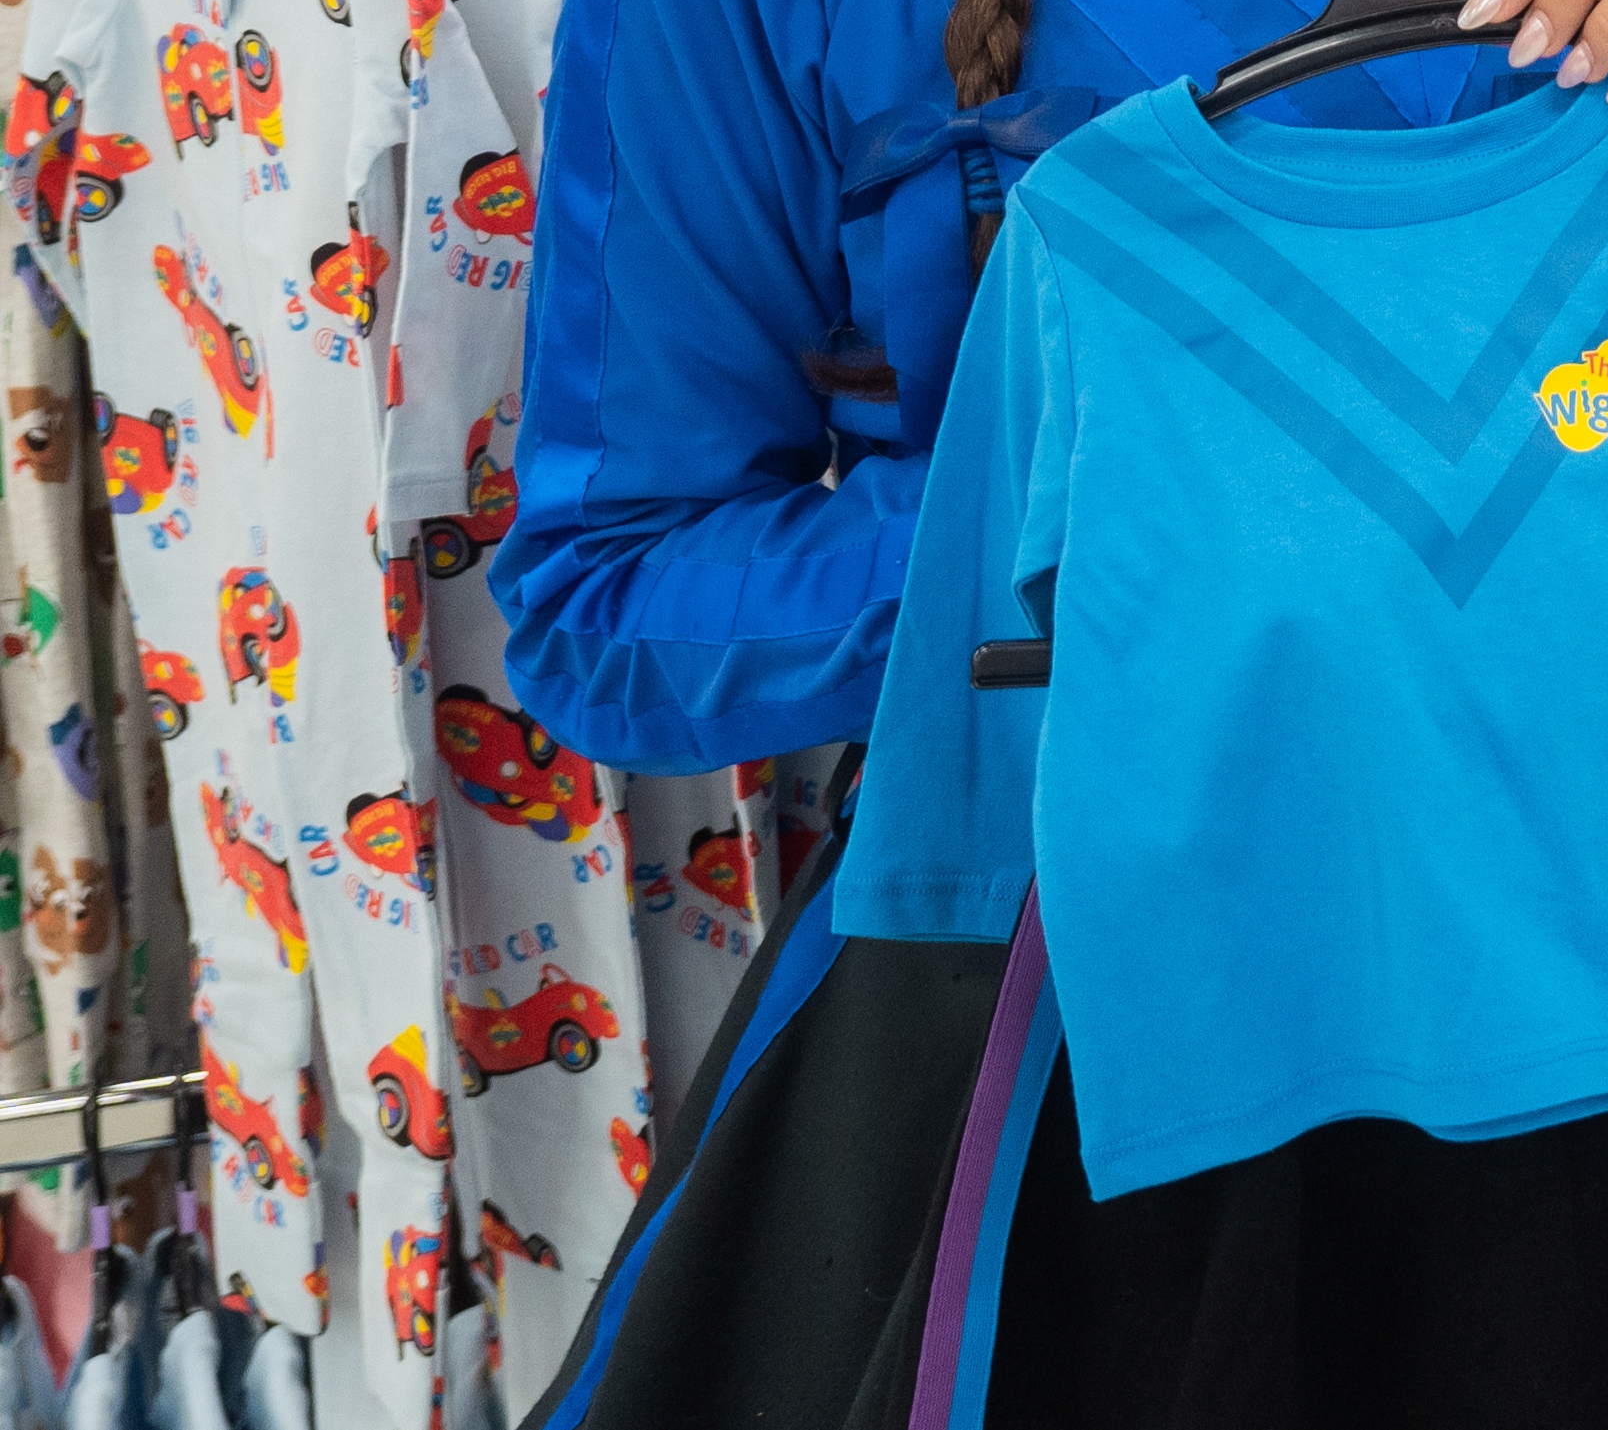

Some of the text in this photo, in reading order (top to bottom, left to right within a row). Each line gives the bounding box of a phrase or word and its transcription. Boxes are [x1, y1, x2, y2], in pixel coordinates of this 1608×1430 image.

[299, 824, 341, 877] CAR
[634, 860, 677, 914] CAR
[505, 921, 559, 963] CAR
